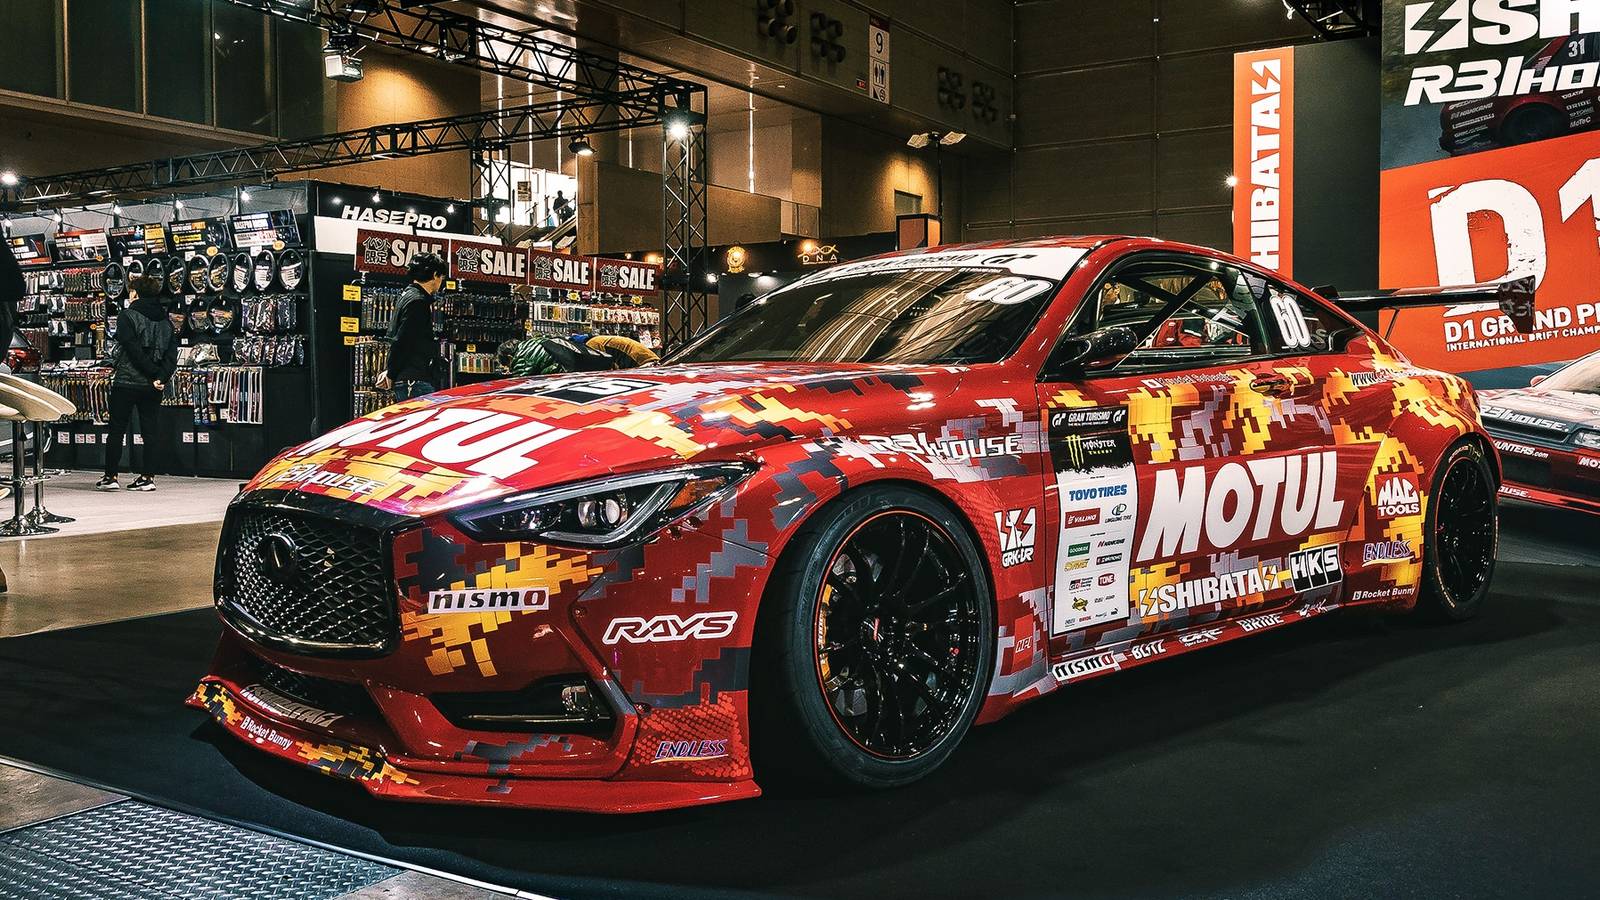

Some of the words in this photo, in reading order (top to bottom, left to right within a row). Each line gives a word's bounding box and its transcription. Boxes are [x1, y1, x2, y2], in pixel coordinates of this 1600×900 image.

[875, 32, 883, 54] 9
[1568, 38, 1585, 58] 31
[1251, 92, 1281, 271] HIBATA
[341, 204, 447, 230] HASEPRO
[363, 237, 391, 250] イベント
[364, 250, 388, 264] 限定
[480, 248, 526, 278] SALE
[552, 257, 589, 285] SALE
[619, 265, 655, 290] SALE
[966, 276, 1053, 305] 60
[1269, 294, 1312, 349] 60
[1444, 320, 1475, 343] D1
[1481, 307, 1572, 337] GRND
[1446, 334, 1526, 352] INTERNATIONAL
[1528, 331, 1558, 342] DRIFT
[285, 408, 581, 478] MOTUL
[1082, 439, 1116, 450] MONSTER
[1069, 486, 1097, 502] TOYO
[1099, 484, 1127, 498] TIRES
[1377, 477, 1419, 505] MAC
[1136, 451, 1346, 562] MOTUL
[1378, 503, 1419, 516] TOOLS
[1290, 547, 1340, 580] HKS
[1363, 540, 1412, 562] ENDLESS
[1100, 575, 1114, 585] TONE
[1157, 566, 1265, 614] SHIBATA
[430, 588, 547, 610] nismo
[1362, 589, 1390, 600] Rocket
[1392, 586, 1415, 598] Bunny
[602, 611, 738, 645] RAYS
[1236, 612, 1285, 632] BRIDE
[1131, 639, 1166, 660] BLITZ
[1054, 653, 1114, 679] nismo
[246, 720, 270, 740] Rocket
[269, 729, 293, 751] Bunny
[655, 739, 728, 759] ENDLESS
